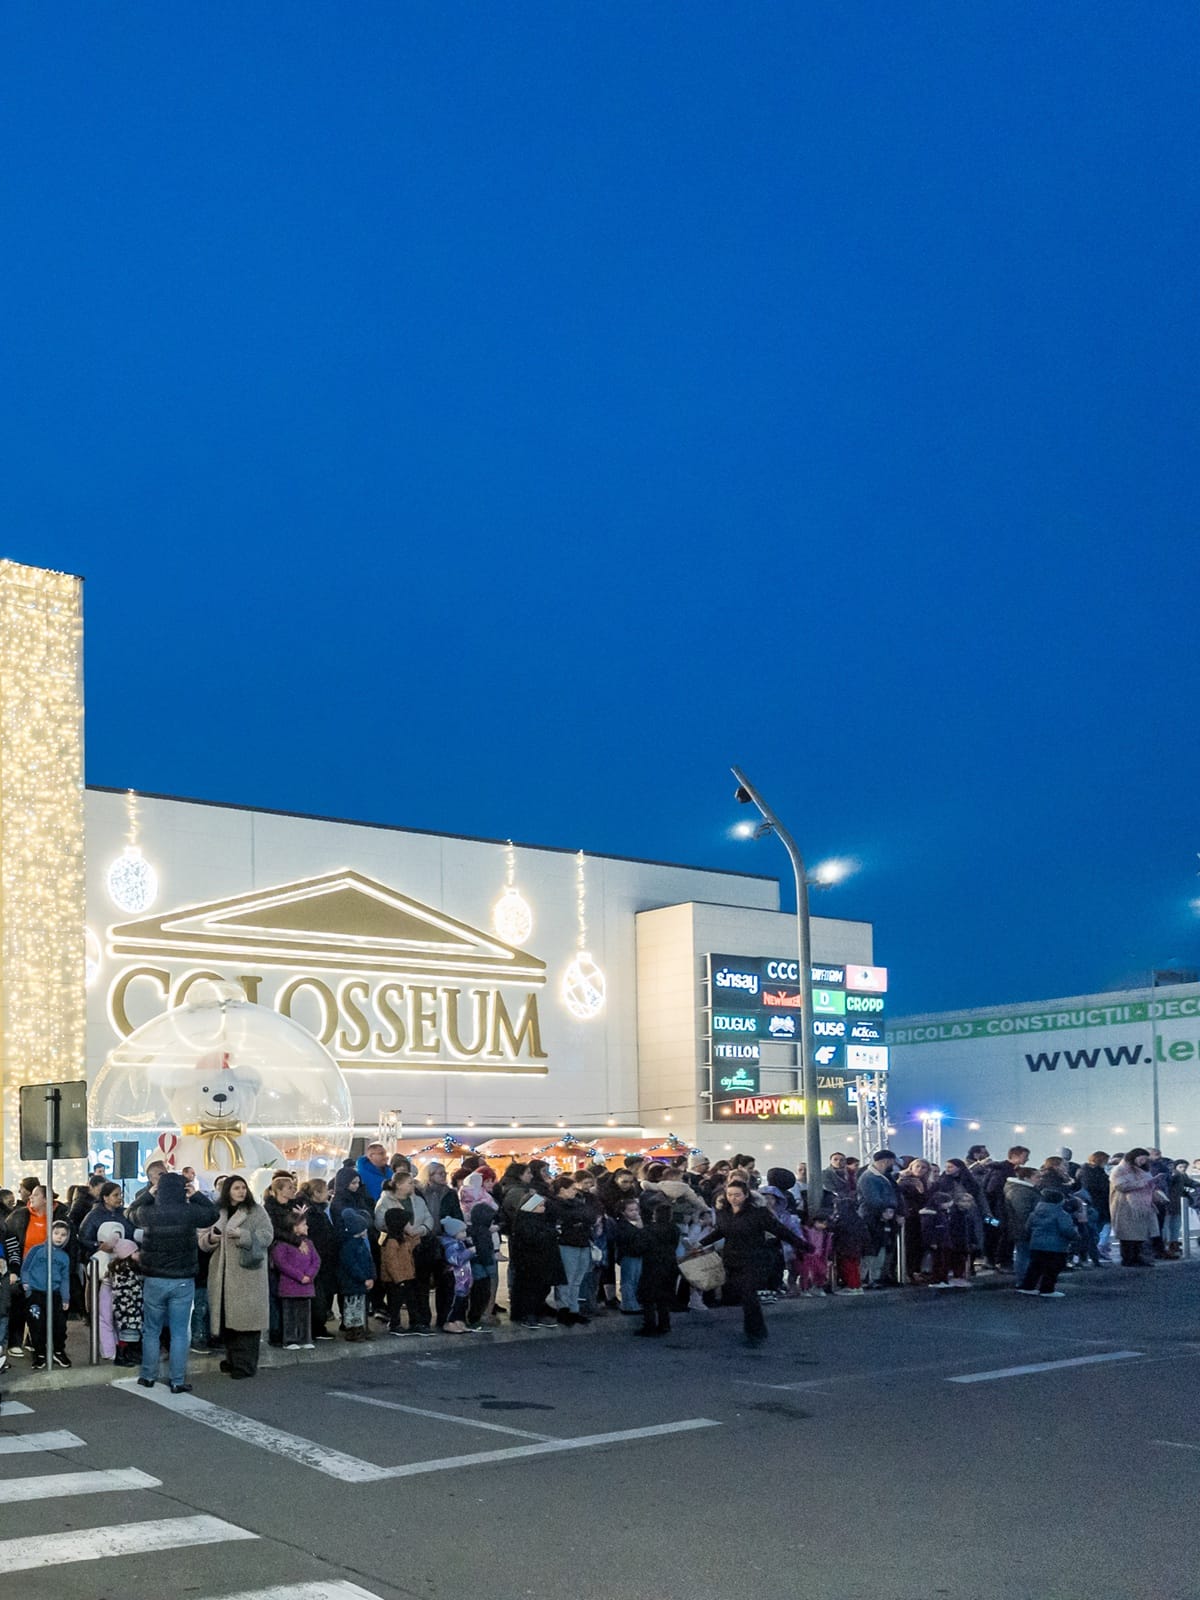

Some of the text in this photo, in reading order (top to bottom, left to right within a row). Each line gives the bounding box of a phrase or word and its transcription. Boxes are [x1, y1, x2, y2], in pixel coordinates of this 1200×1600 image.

[767, 961, 798, 980] CCC
[716, 968, 758, 994] sinsay
[847, 996, 884, 1012] CROPP
[714, 1016, 756, 1031] DOUGLAS
[813, 1021, 846, 1036] ouse
[885, 1023, 973, 1044] BRICOLAJ
[1147, 1000, 1200, 1018] DEC
[715, 1045, 760, 1058] TEILOR
[815, 1046, 836, 1064] 4F
[1025, 1034, 1200, 1072] www.le
[817, 1076, 845, 1088] ZAUR
